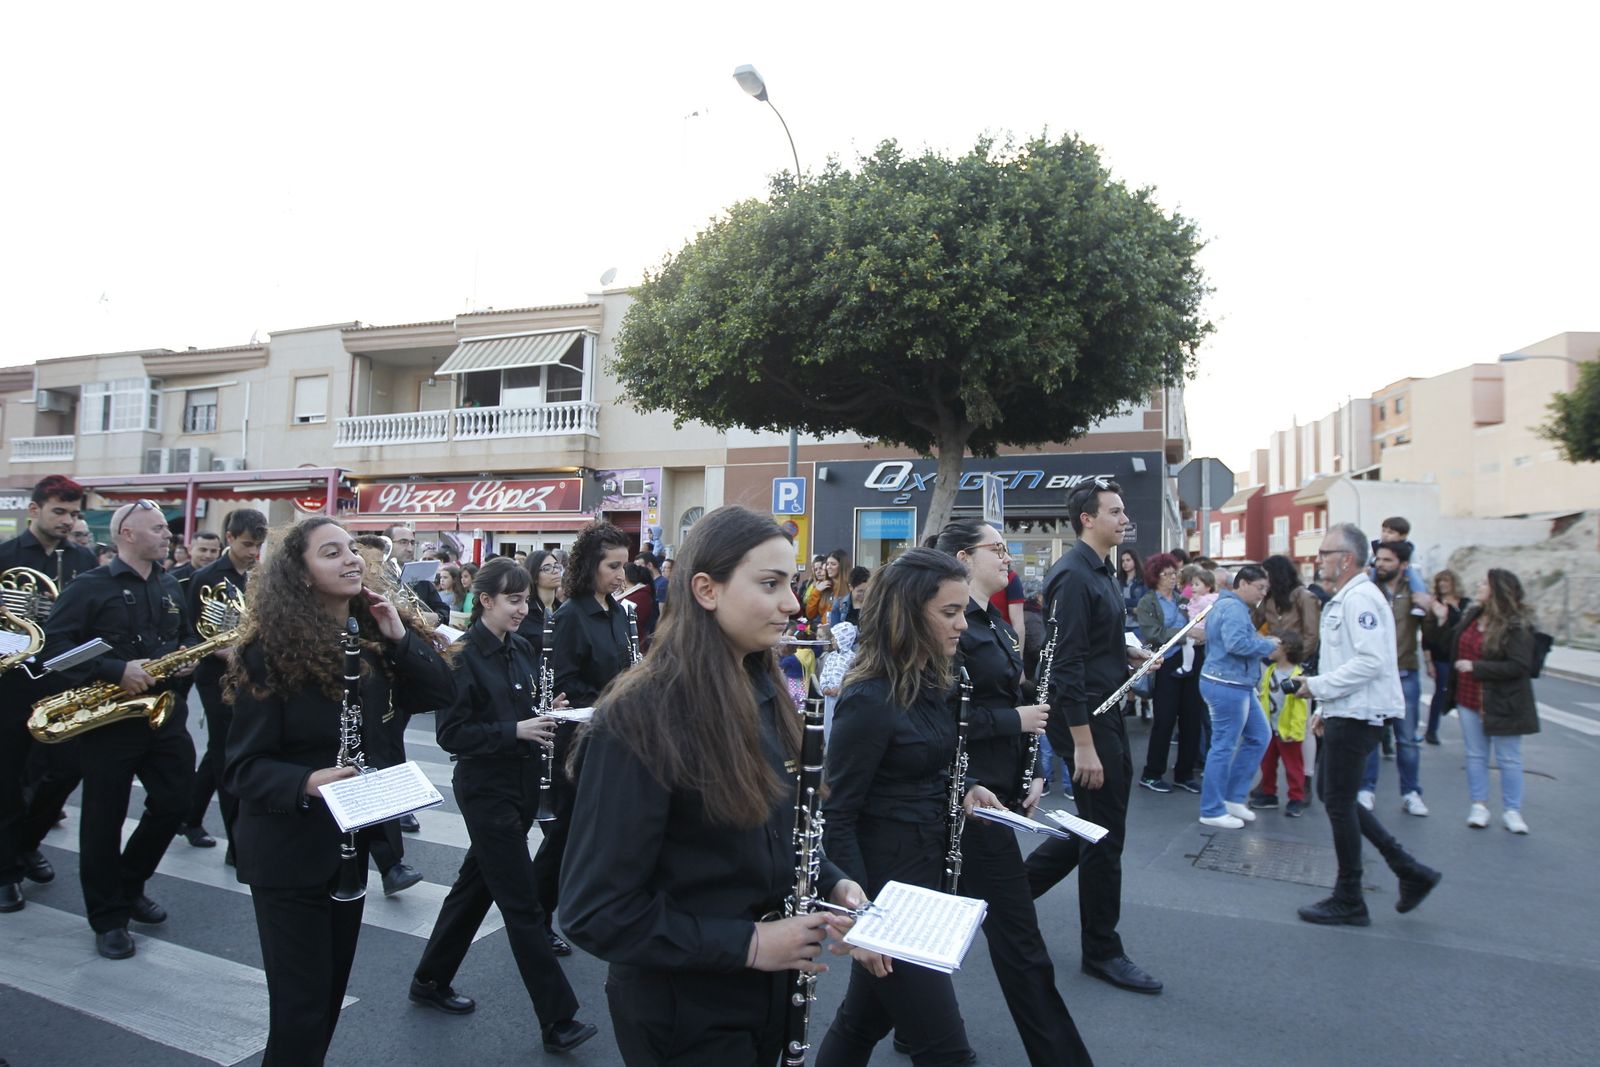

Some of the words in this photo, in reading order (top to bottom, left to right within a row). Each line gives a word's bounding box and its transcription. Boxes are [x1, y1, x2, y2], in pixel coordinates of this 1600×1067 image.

[378, 483, 456, 513] Pizza
[459, 481, 555, 513] López
[779, 482, 798, 510] P
